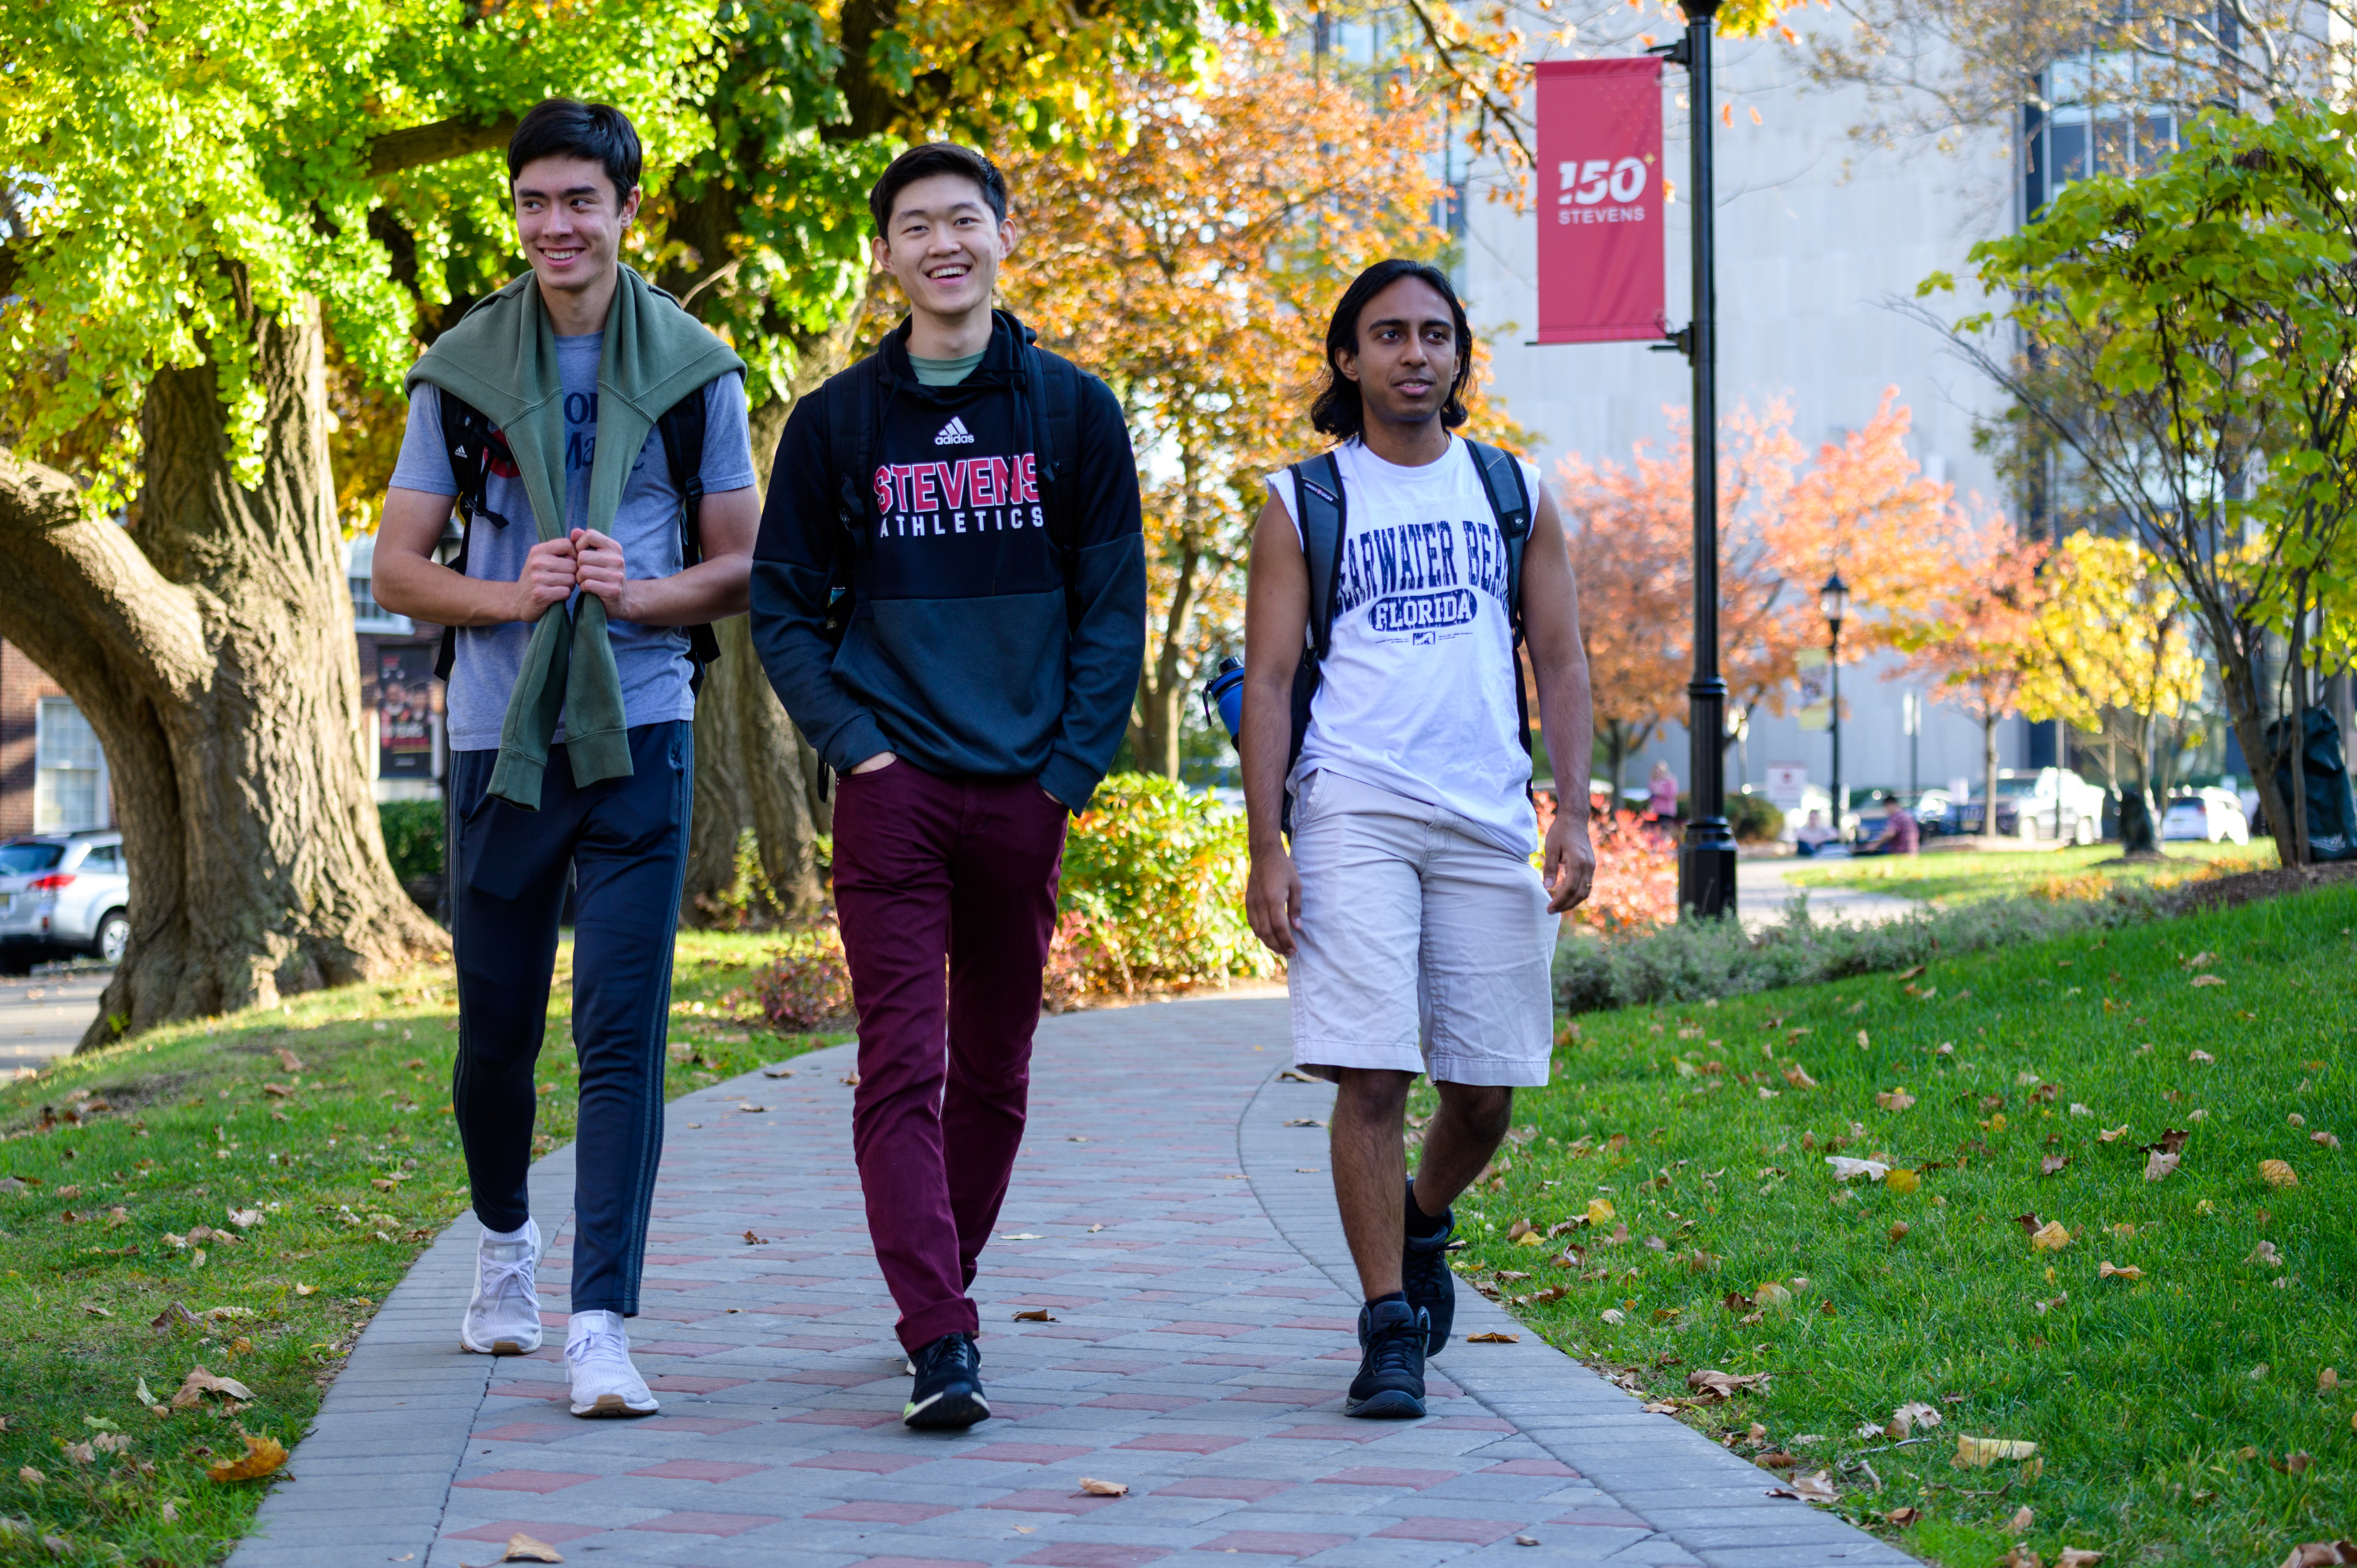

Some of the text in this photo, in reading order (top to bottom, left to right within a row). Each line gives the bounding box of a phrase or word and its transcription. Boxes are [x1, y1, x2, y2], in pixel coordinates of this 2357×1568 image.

[1558, 156, 1647, 205] 150
[1558, 205, 1645, 225] STEVENS
[935, 434, 974, 445] adidas
[874, 453, 1040, 515] STEVENS
[880, 507, 1044, 538] ATHLETICS
[1375, 593, 1472, 630] FLORIDA
[1382, 1305, 1402, 1316] NIKE
